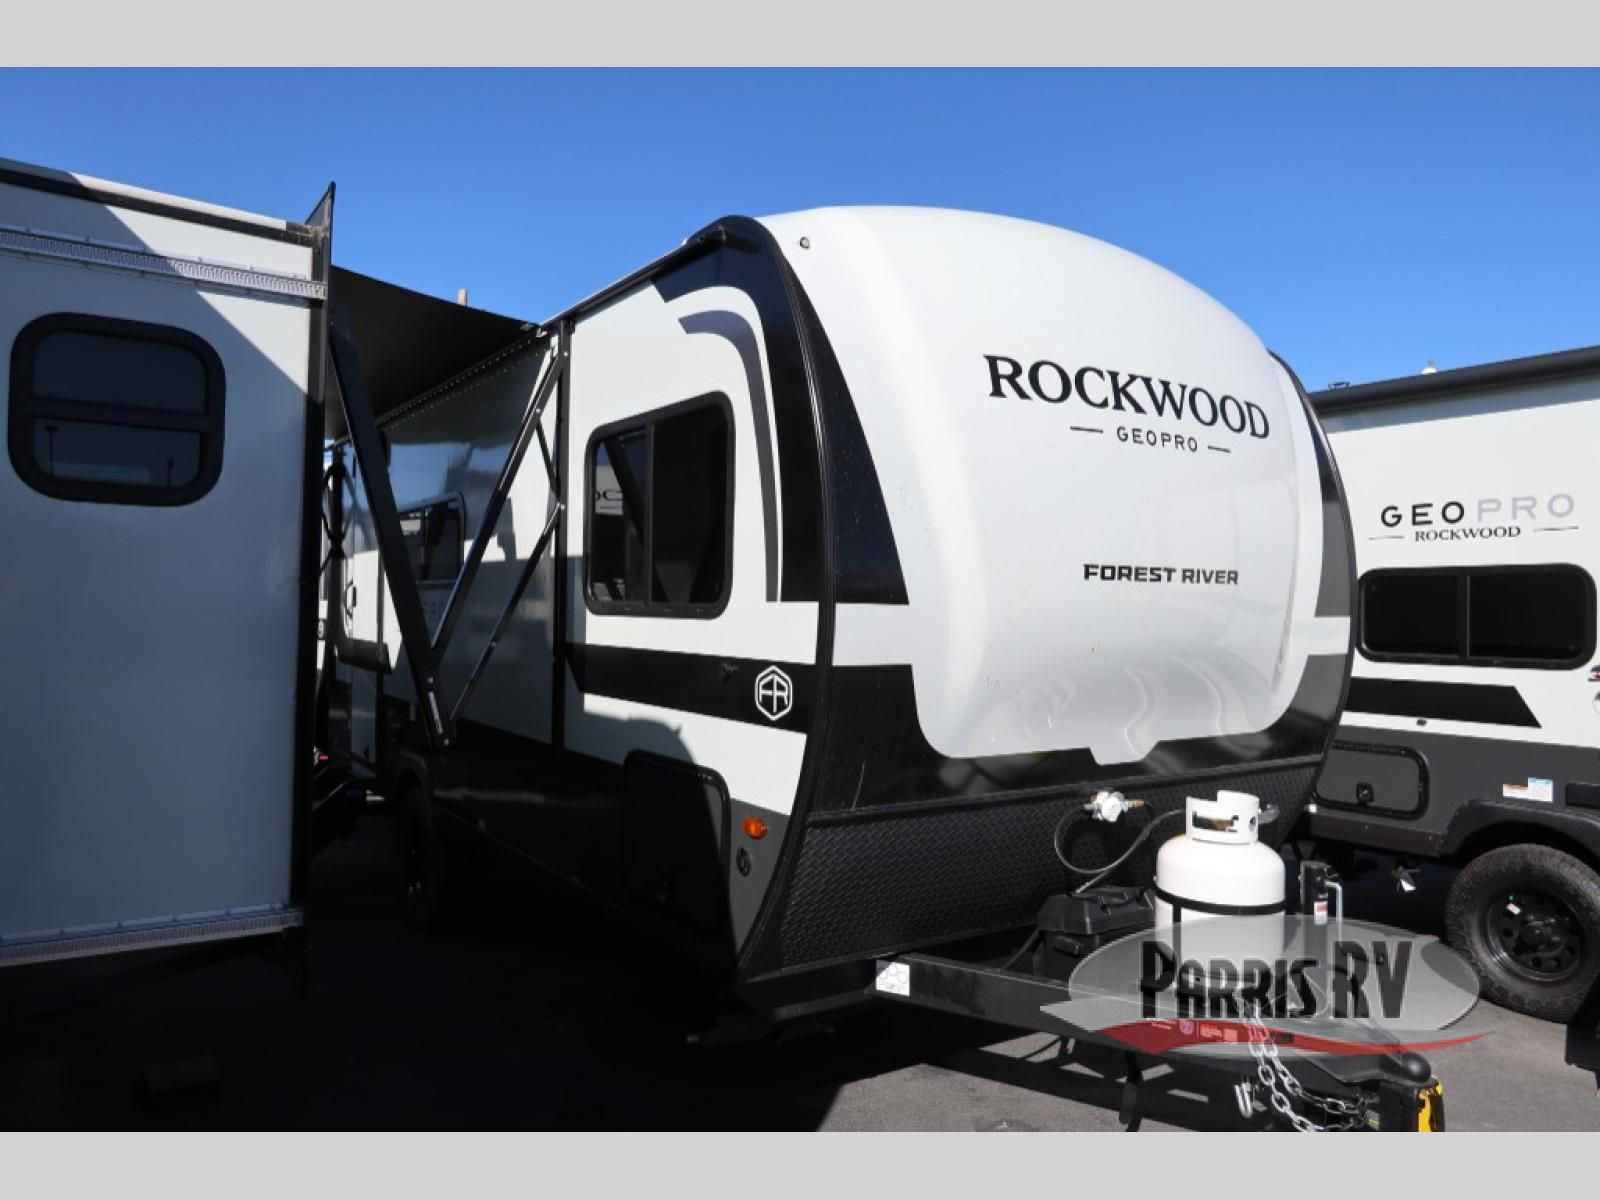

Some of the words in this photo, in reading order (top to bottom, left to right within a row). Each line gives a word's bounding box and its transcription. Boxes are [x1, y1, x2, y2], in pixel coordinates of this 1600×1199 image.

[983, 354, 1270, 439] ROCKWOOD
[1116, 426, 1198, 452] GEOPRO
[1414, 526, 1521, 543] ROCKWOOD
[1083, 564, 1177, 583] FOREST
[1182, 568, 1239, 585] RIVER
